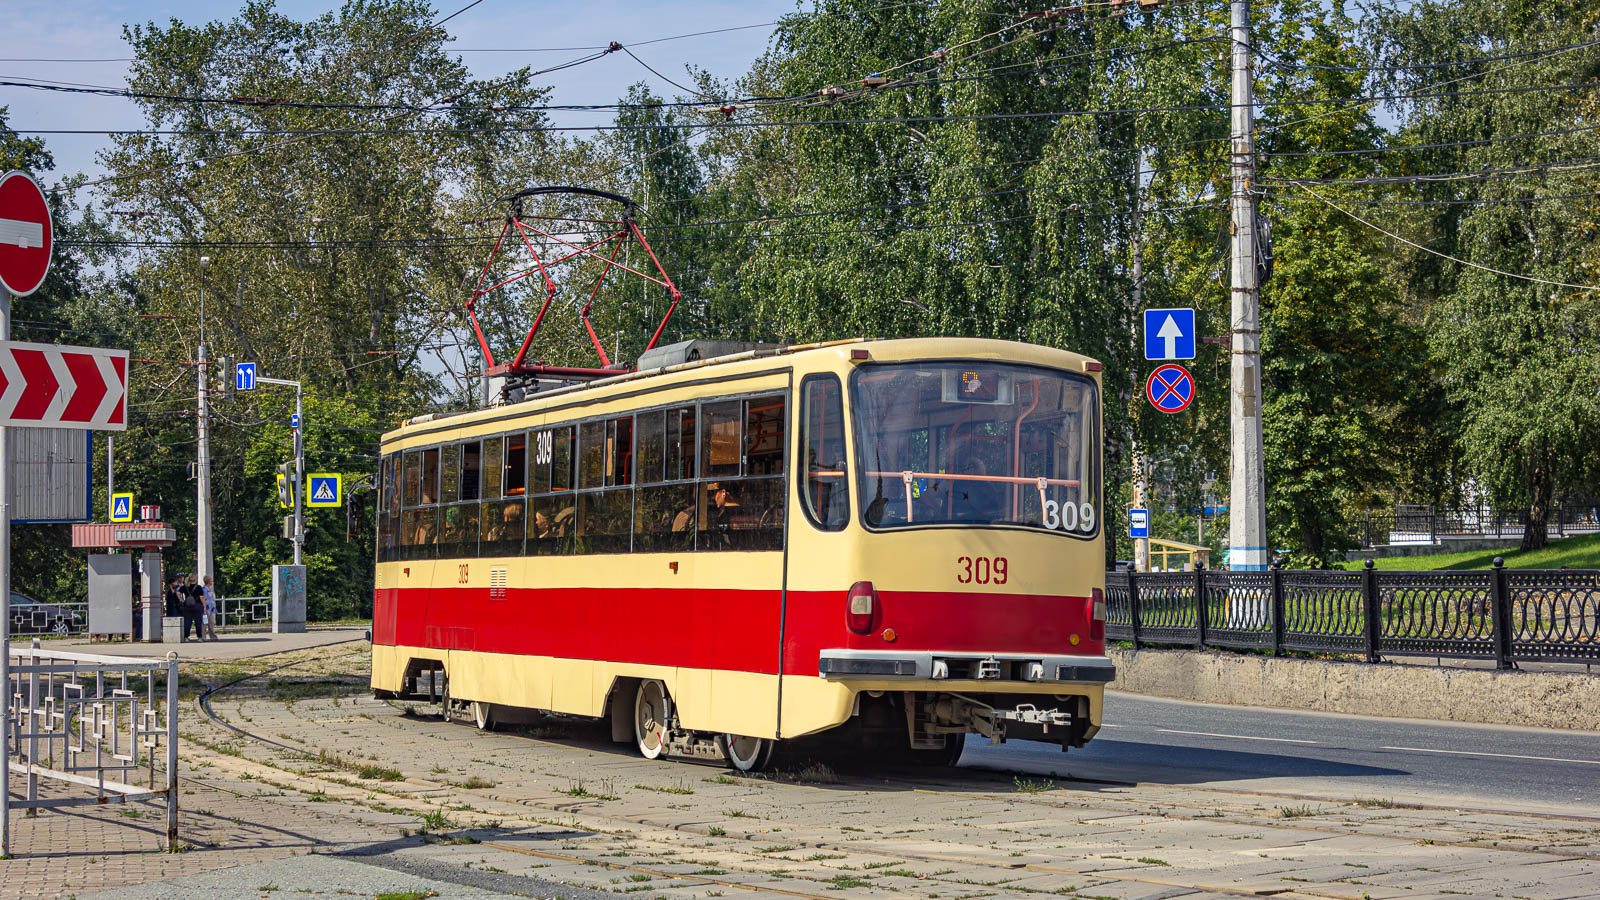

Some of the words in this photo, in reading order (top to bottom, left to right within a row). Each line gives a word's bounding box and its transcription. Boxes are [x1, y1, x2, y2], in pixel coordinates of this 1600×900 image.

[536, 430, 552, 465] 309
[1044, 500, 1095, 532] 309
[458, 563, 469, 584] 309
[957, 556, 1008, 585] 309
